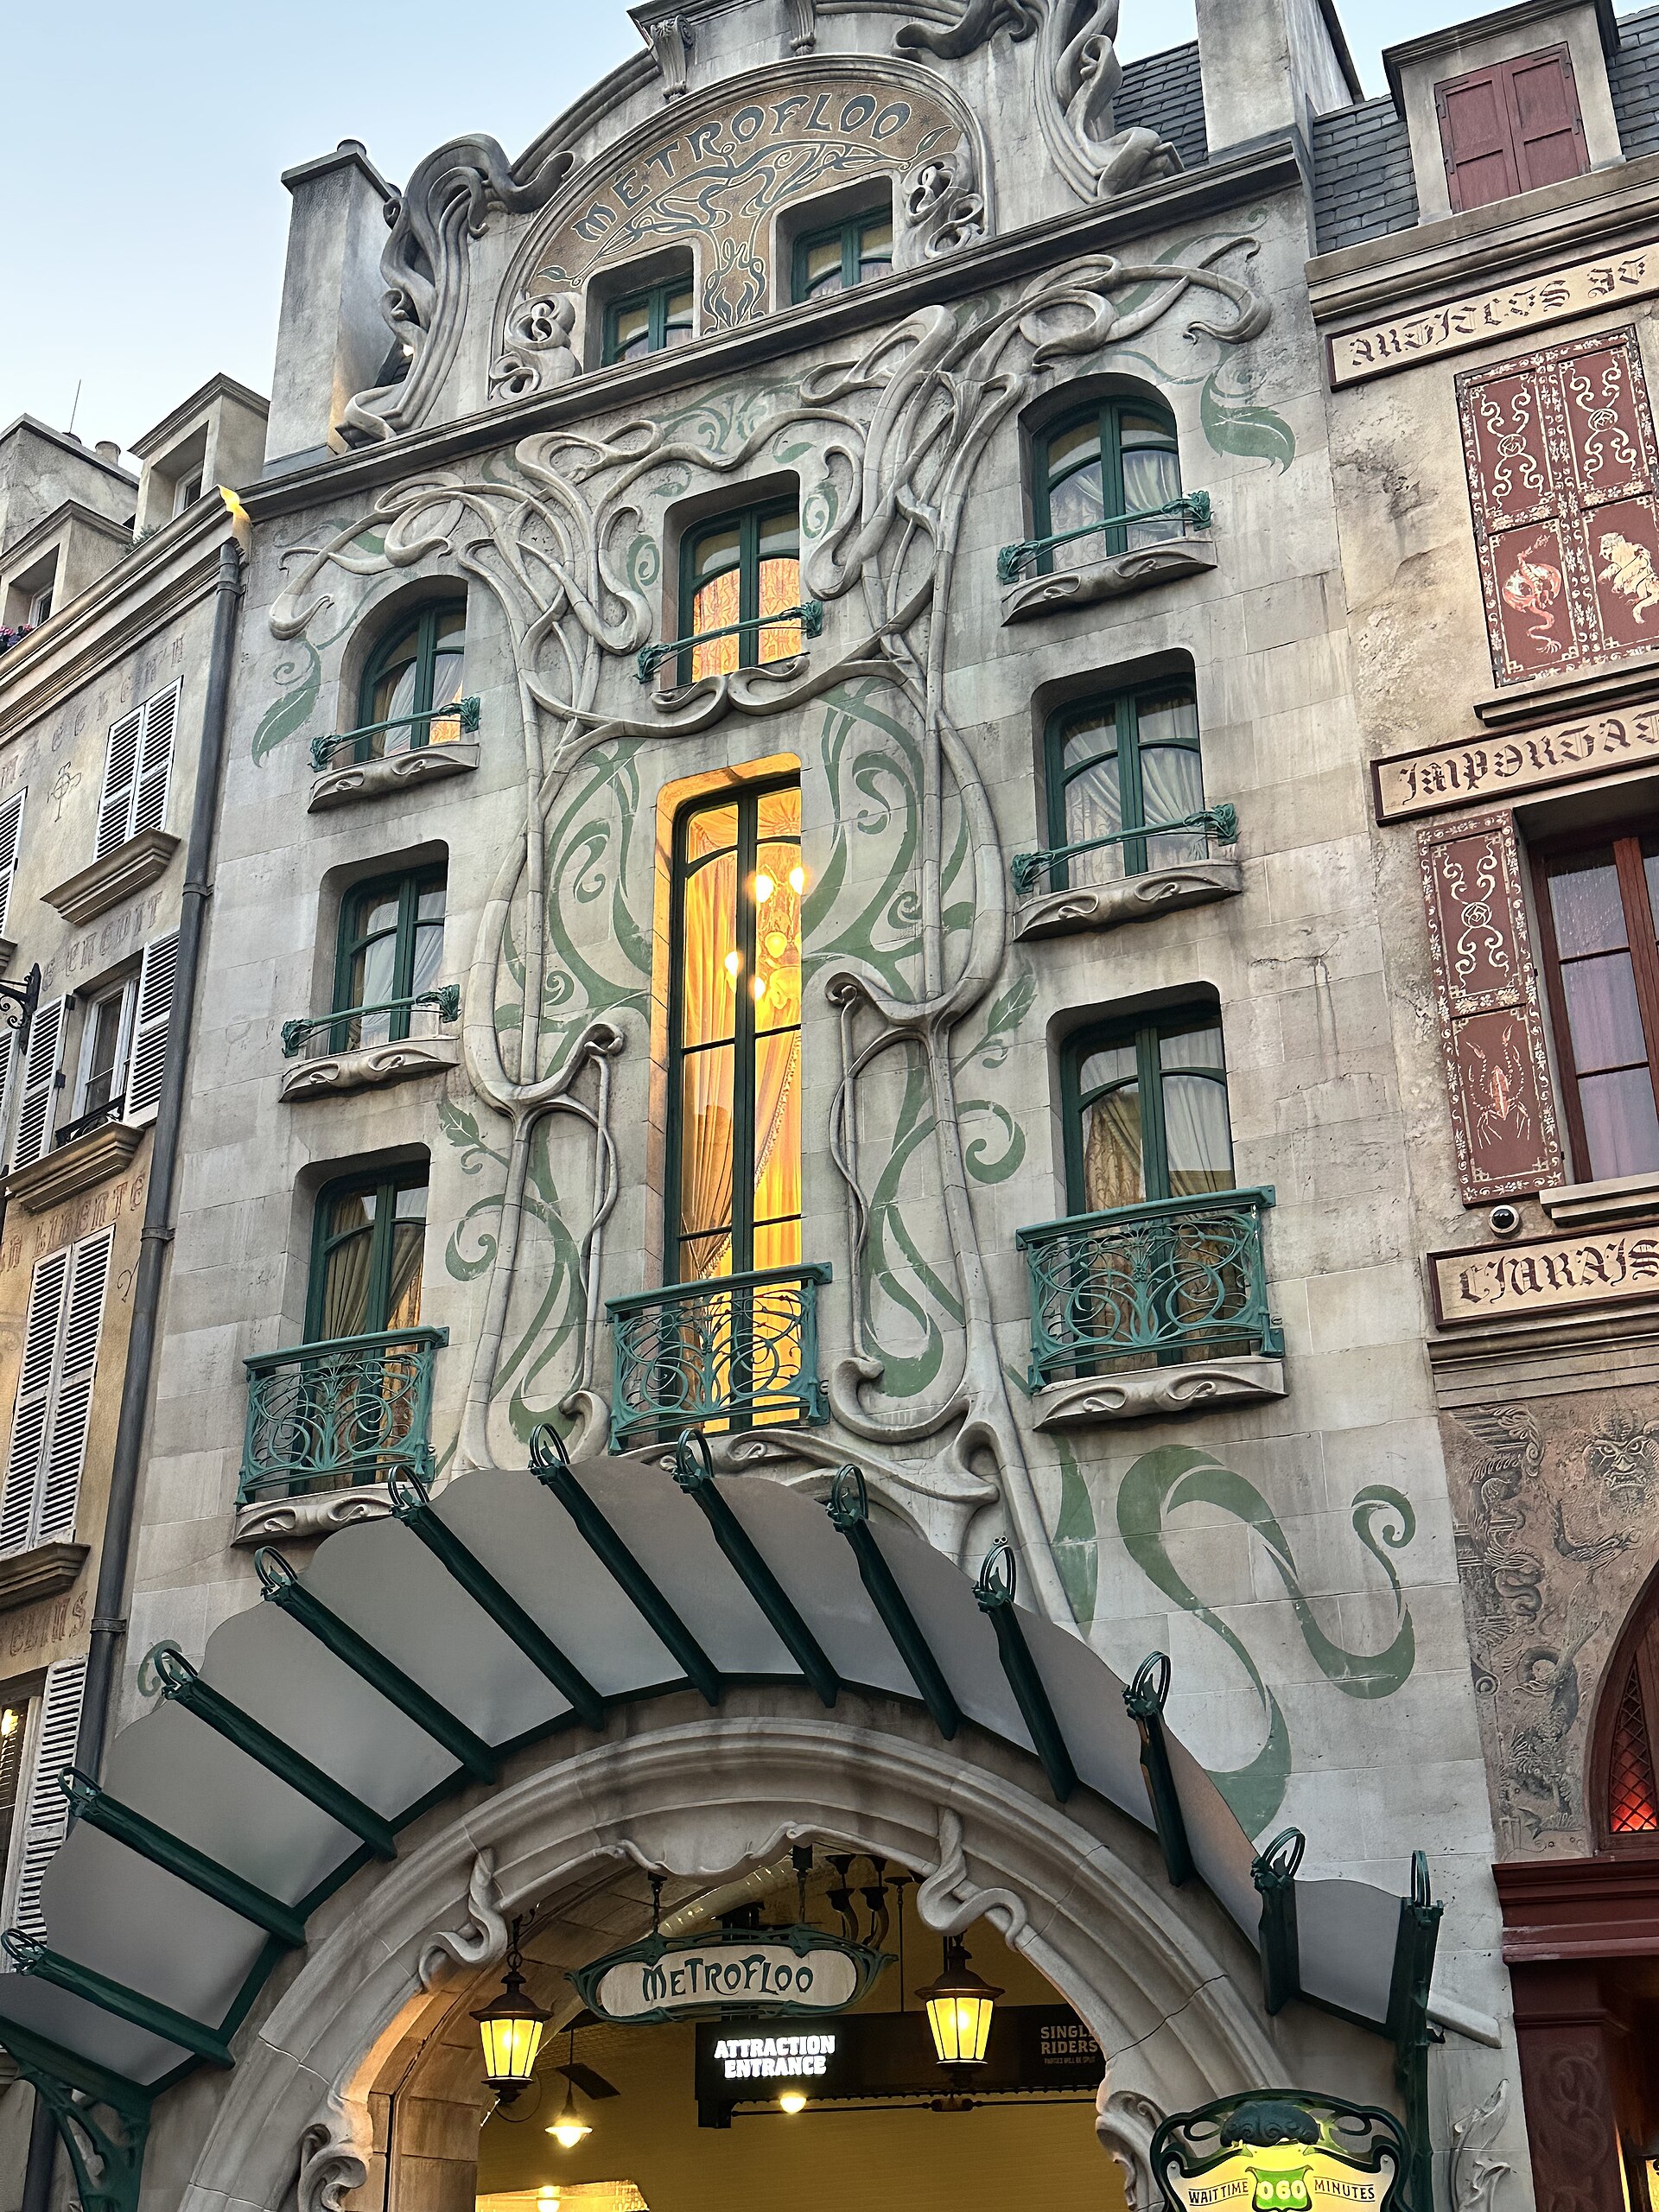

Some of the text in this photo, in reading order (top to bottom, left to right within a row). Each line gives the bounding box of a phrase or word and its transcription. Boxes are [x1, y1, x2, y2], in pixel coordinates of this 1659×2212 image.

[571, 92, 912, 242] METROFLOO
[642, 1954, 814, 2001] METROFLOO
[1040, 2025, 1091, 2039] SINGL
[714, 2035, 836, 2059] ATTRACTION
[1040, 2039, 1098, 2055] RIDERS
[724, 2056, 827, 2078] ENTRANCE
[1256, 2180, 1305, 2201] 060
[1314, 2180, 1375, 2200] MINUTES
